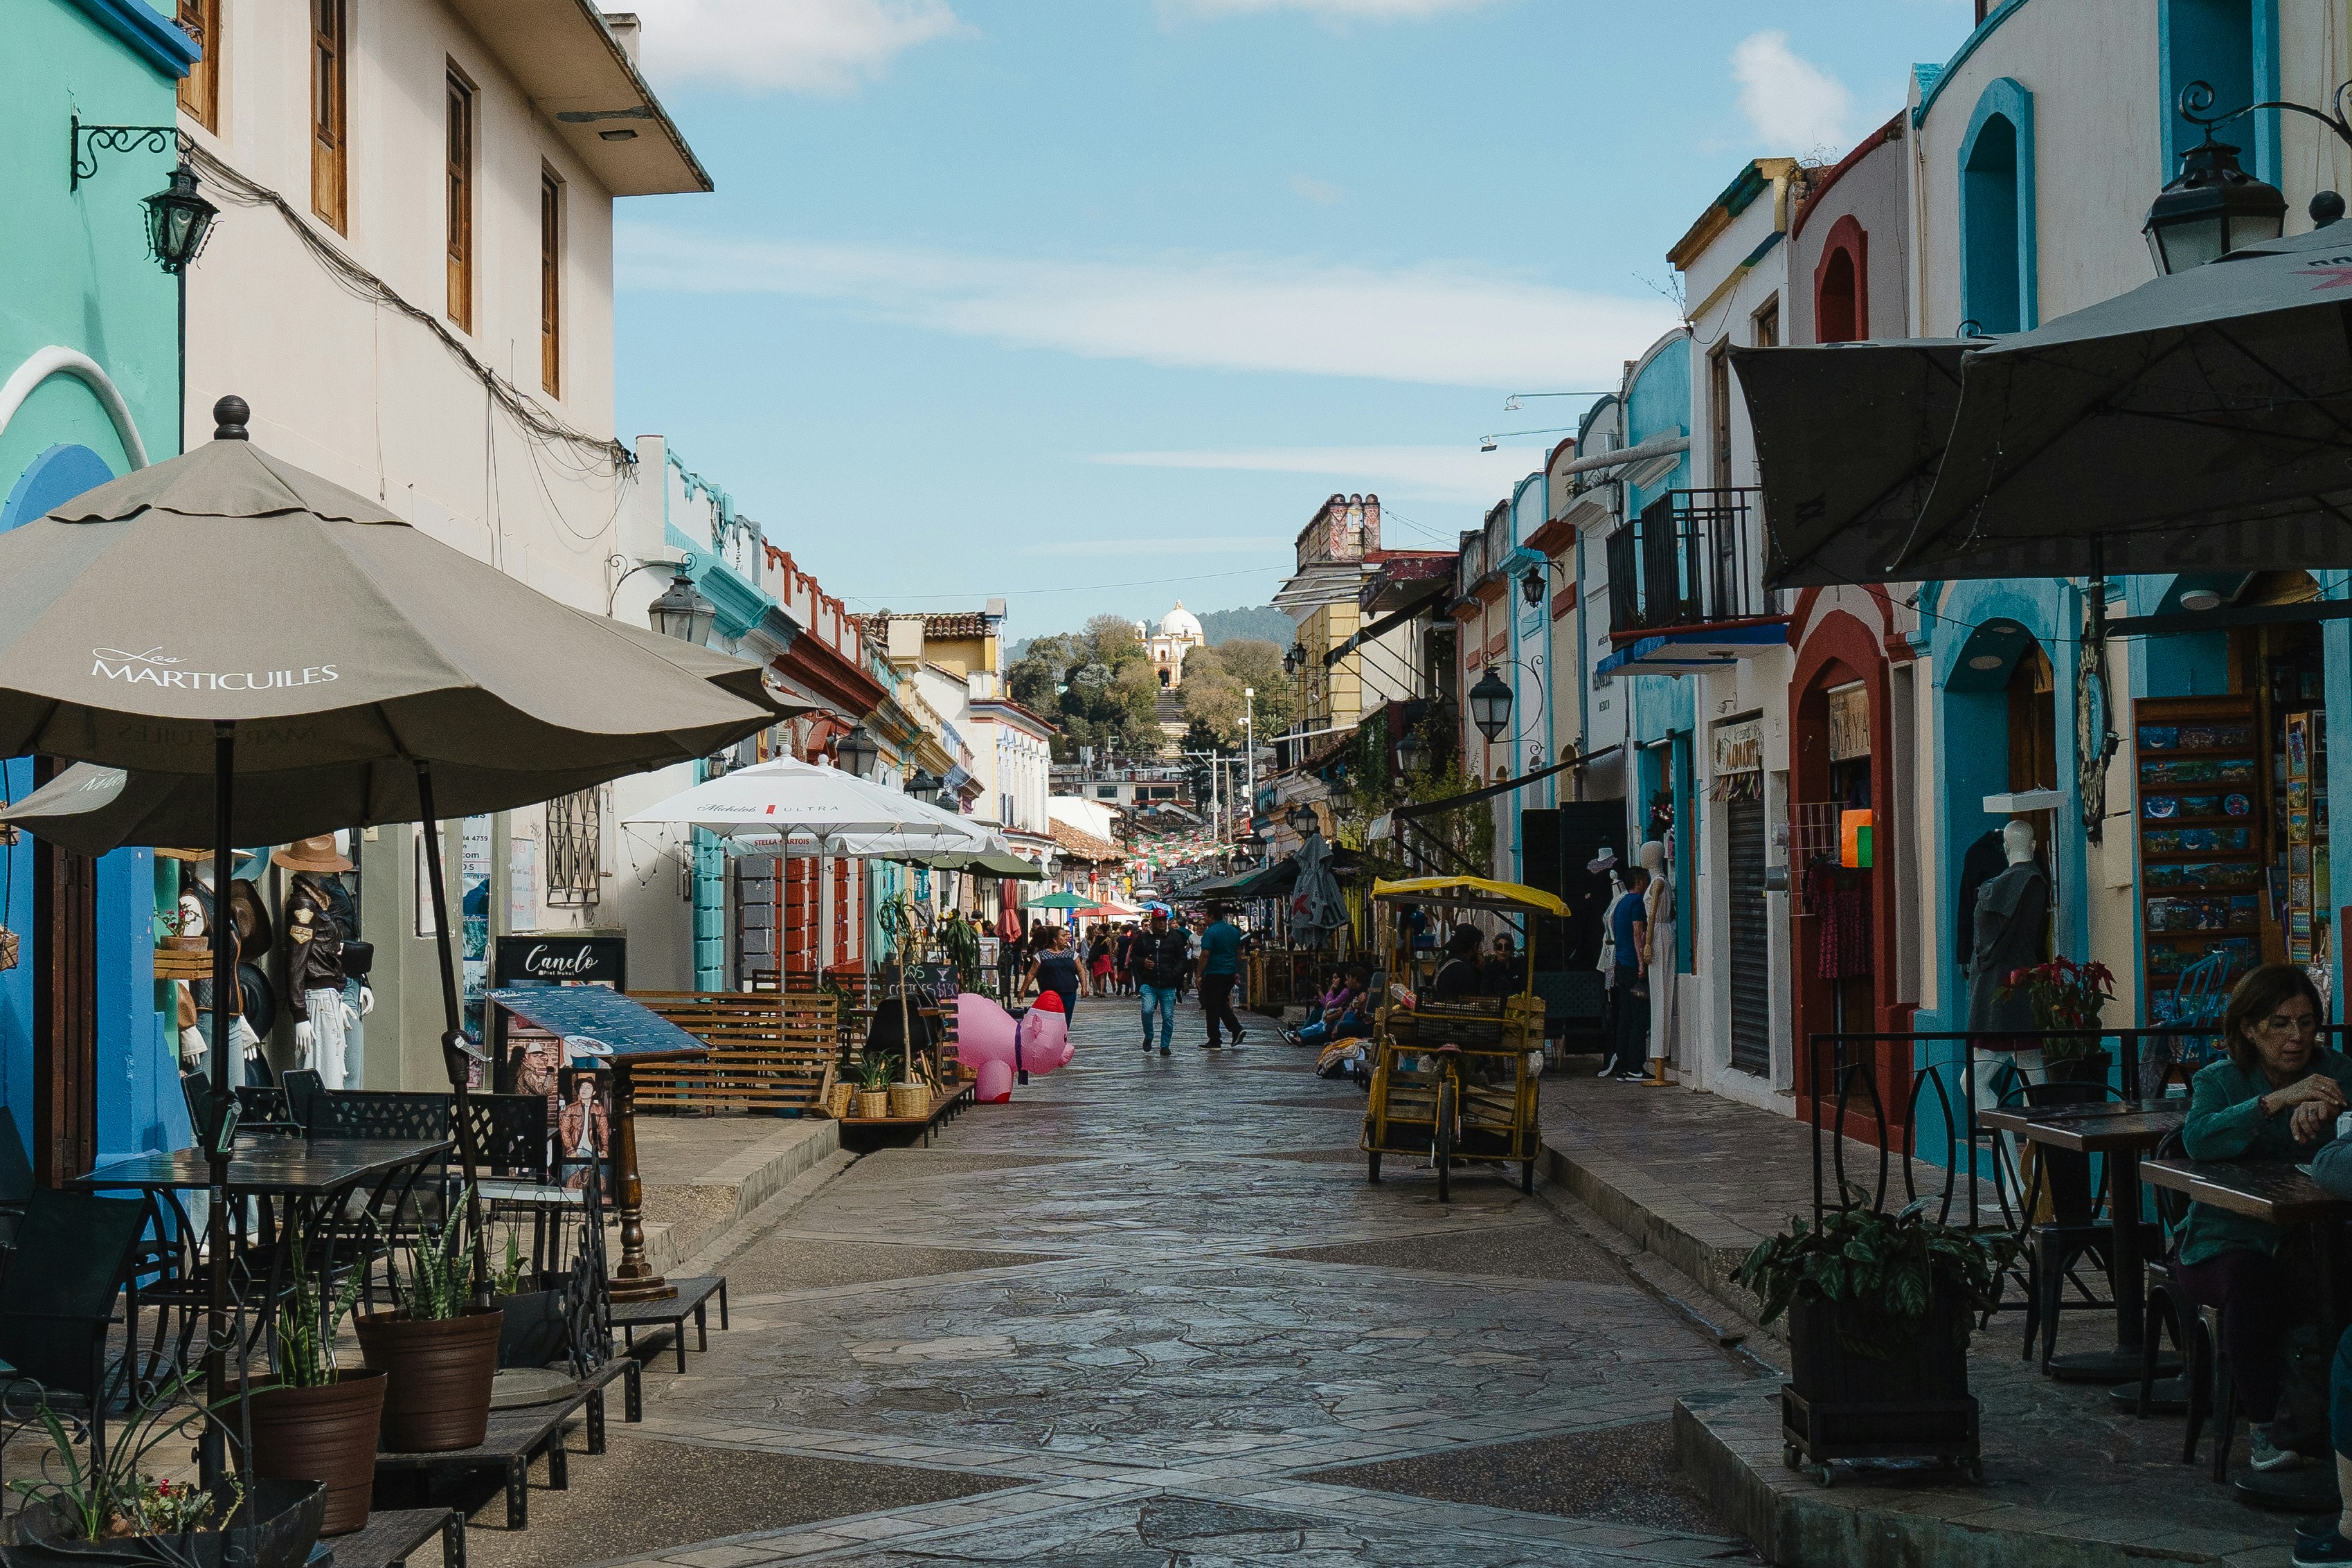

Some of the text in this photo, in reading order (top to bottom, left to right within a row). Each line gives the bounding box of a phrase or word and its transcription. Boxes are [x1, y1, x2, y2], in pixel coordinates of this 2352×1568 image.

[91, 659, 339, 690] MARTICUILES
[697, 803, 757, 813] Michelob
[525, 944, 599, 973] Canelo
[937, 982, 958, 998] $130
